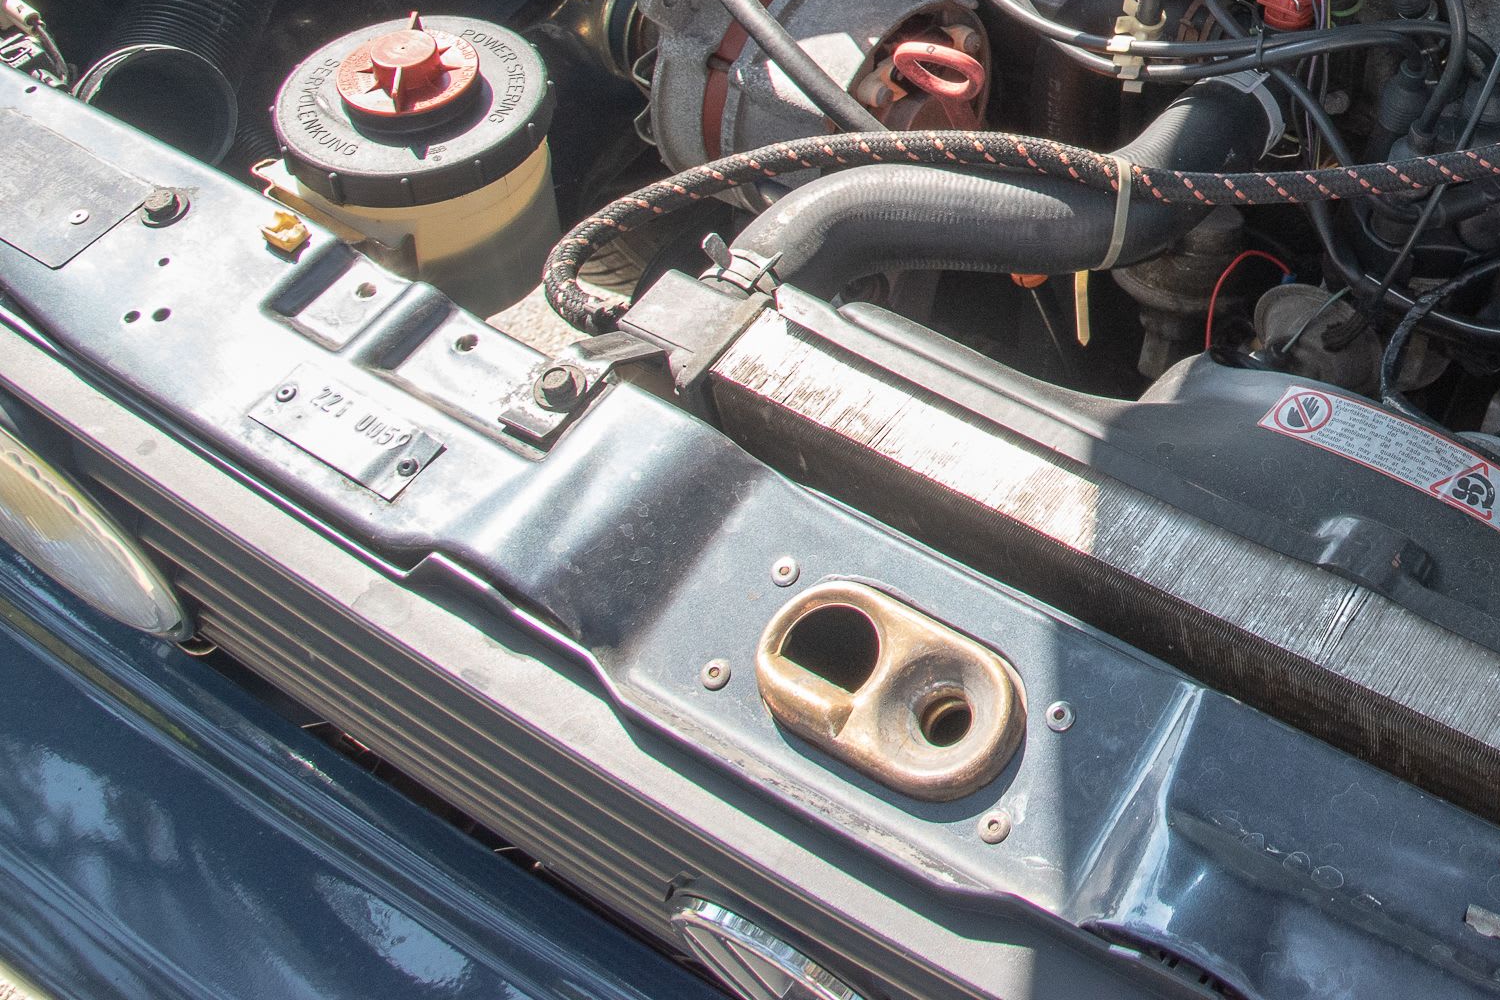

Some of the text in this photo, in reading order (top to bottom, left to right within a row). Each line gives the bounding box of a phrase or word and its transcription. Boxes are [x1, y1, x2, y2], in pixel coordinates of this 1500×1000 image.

[459, 28, 527, 125] POWER STEERING
[296, 57, 360, 157] SERVOLENKUNG
[1374, 412, 1388, 421] peut
[1435, 438, 1448, 448] tout
[1358, 446, 1371, 456] may
[1374, 453, 1389, 463] start
[1406, 447, 1421, 456] cada
